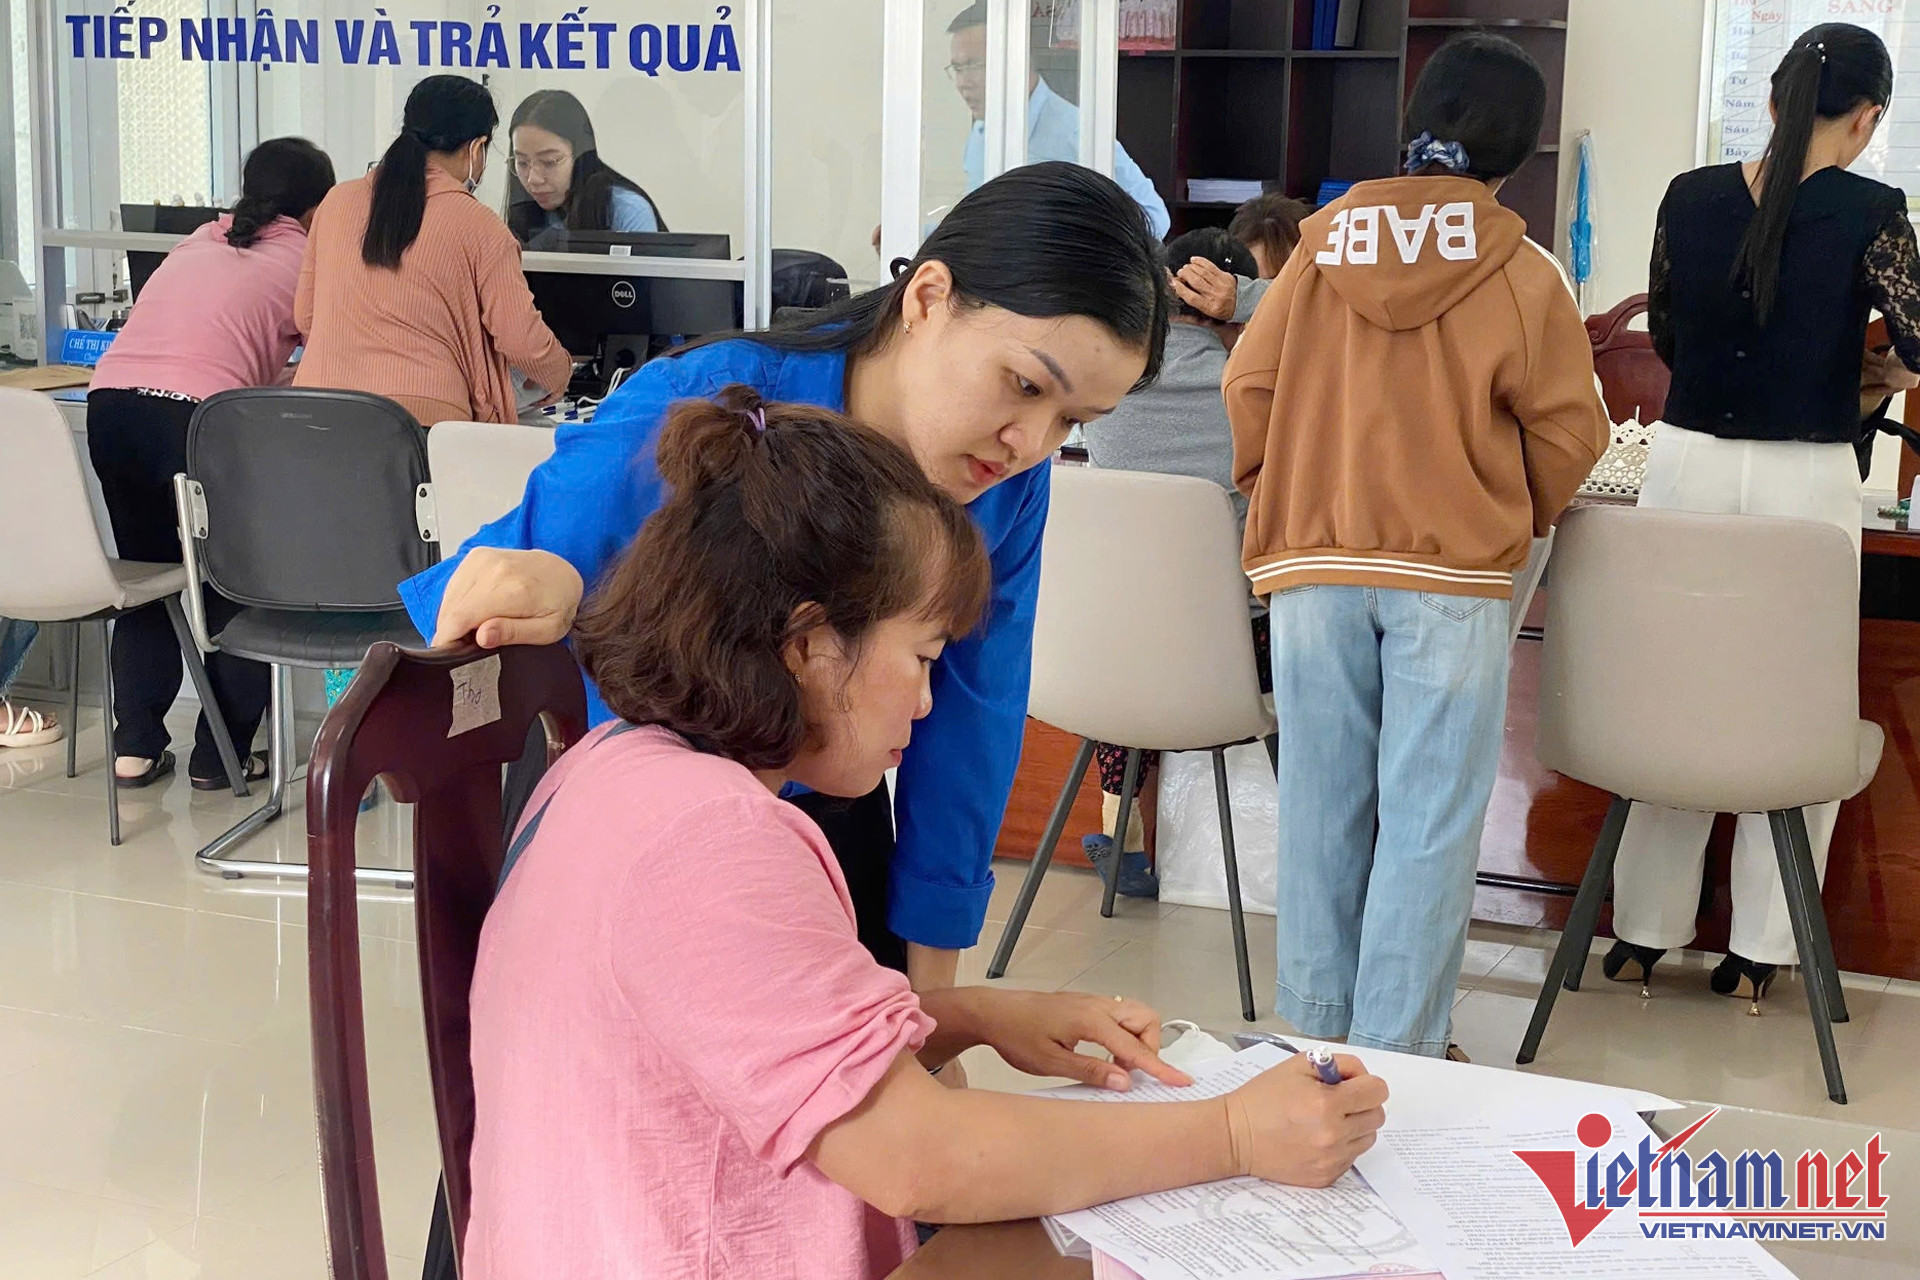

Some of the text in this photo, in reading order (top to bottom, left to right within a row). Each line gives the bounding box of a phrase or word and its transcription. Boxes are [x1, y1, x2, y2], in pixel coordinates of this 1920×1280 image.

[65, 1, 742, 77] TIẾP NHẬN VÀ TRẢ KẾT QUẢ
[1315, 201, 1477, 266] BABE
[614, 290, 633, 298] DELL
[101, 340, 112, 351] KI
